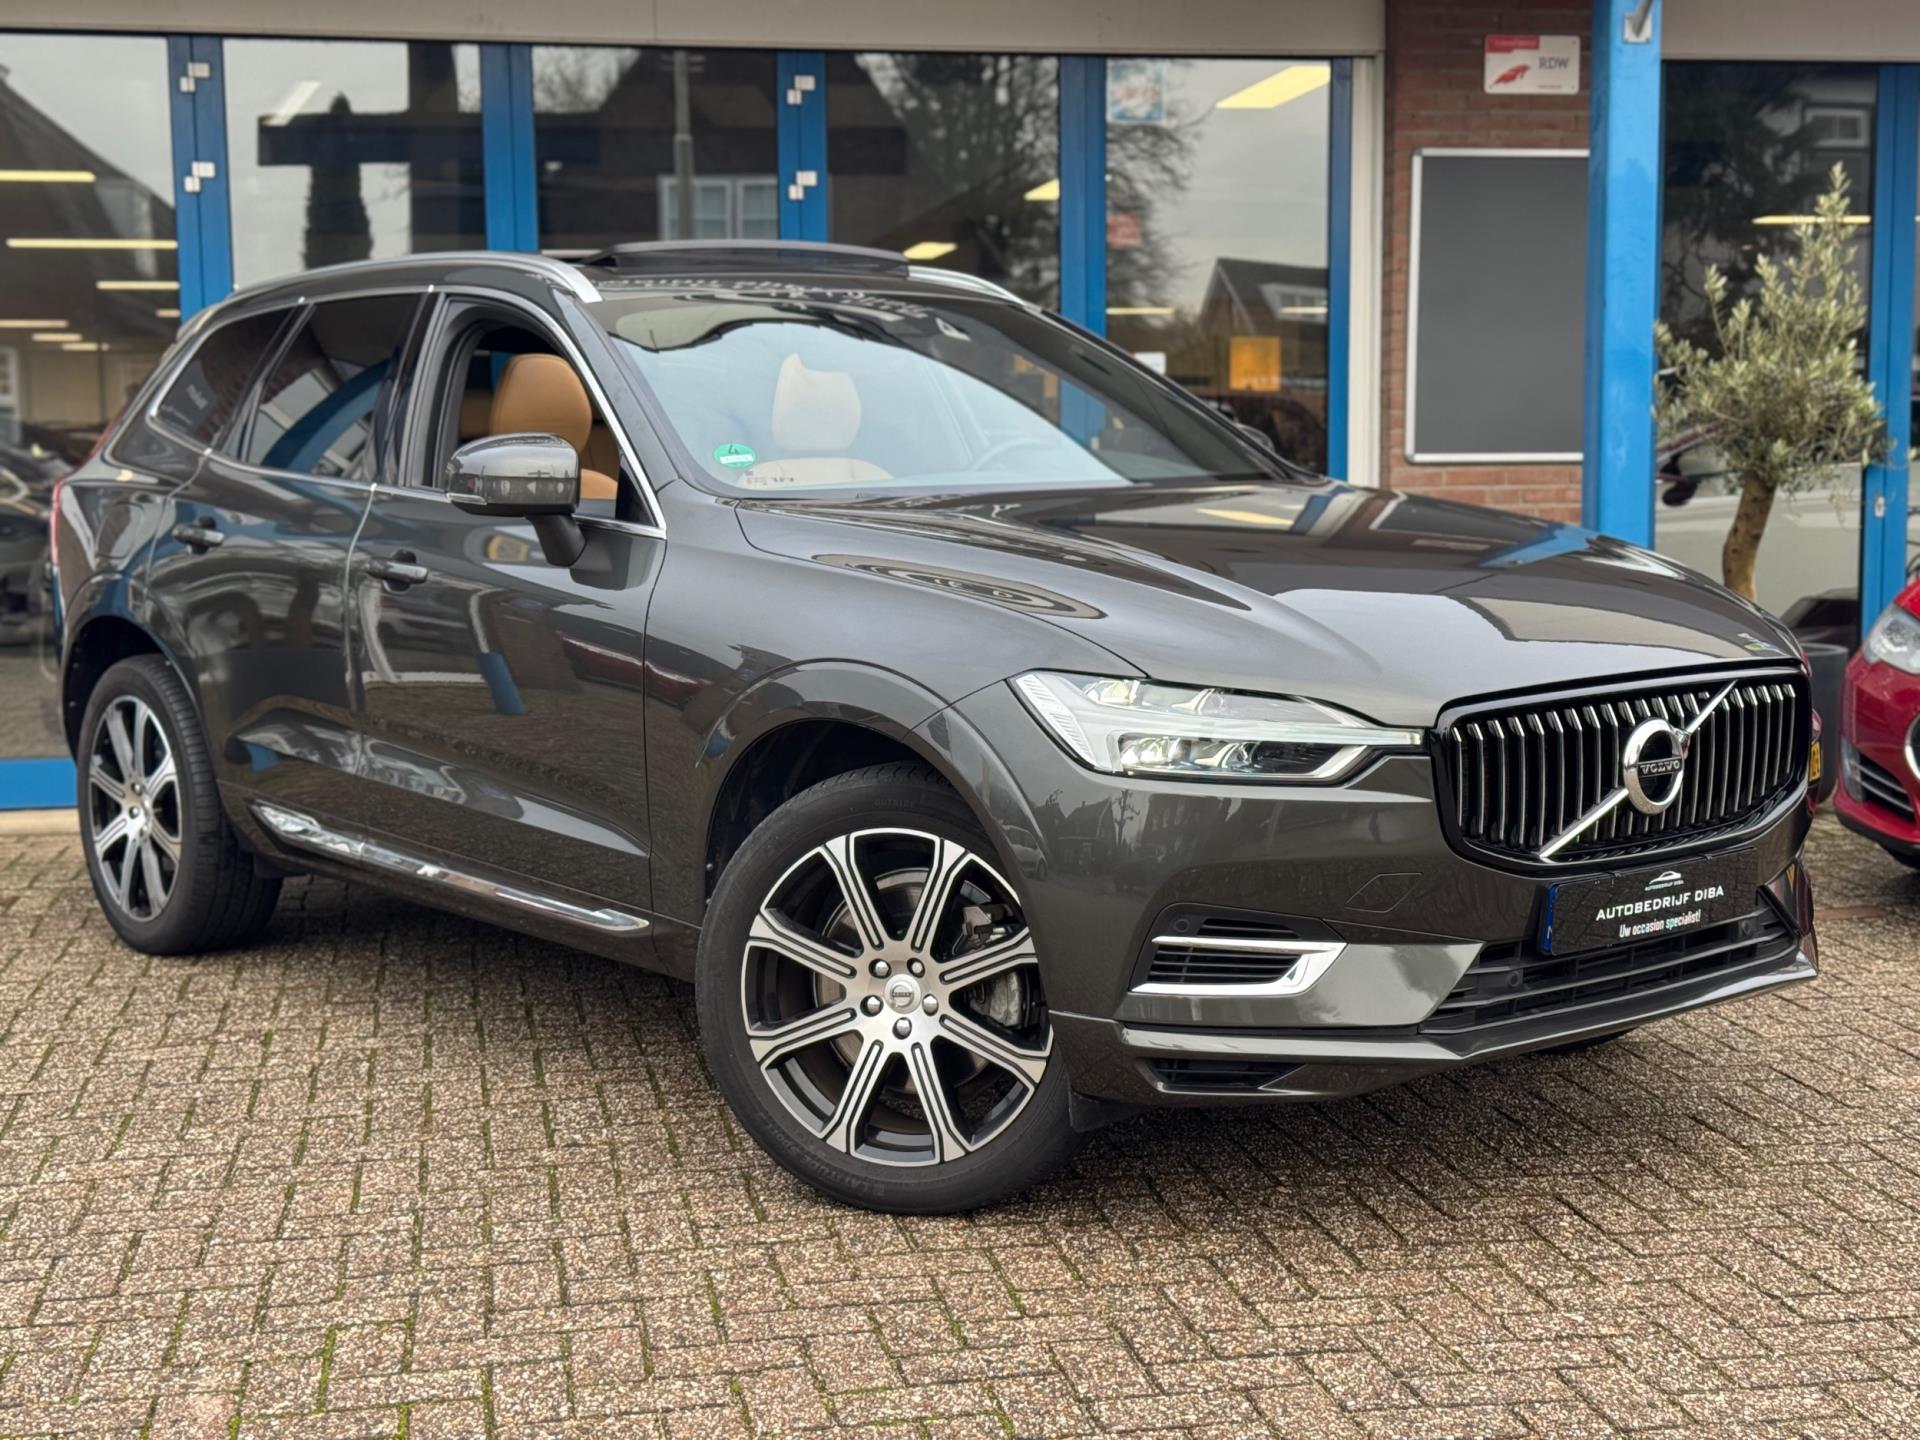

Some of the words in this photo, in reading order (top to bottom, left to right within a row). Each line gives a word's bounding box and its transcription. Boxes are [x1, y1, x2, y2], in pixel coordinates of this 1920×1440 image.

[1538, 56, 1570, 69] RDW
[1596, 892, 1692, 921] AUTOBEDRIJF
[1694, 885, 1724, 902] DIBA
[1619, 924, 1632, 938] Uw
[1632, 918, 1665, 935] occasion
[1665, 909, 1702, 930] specialist!
